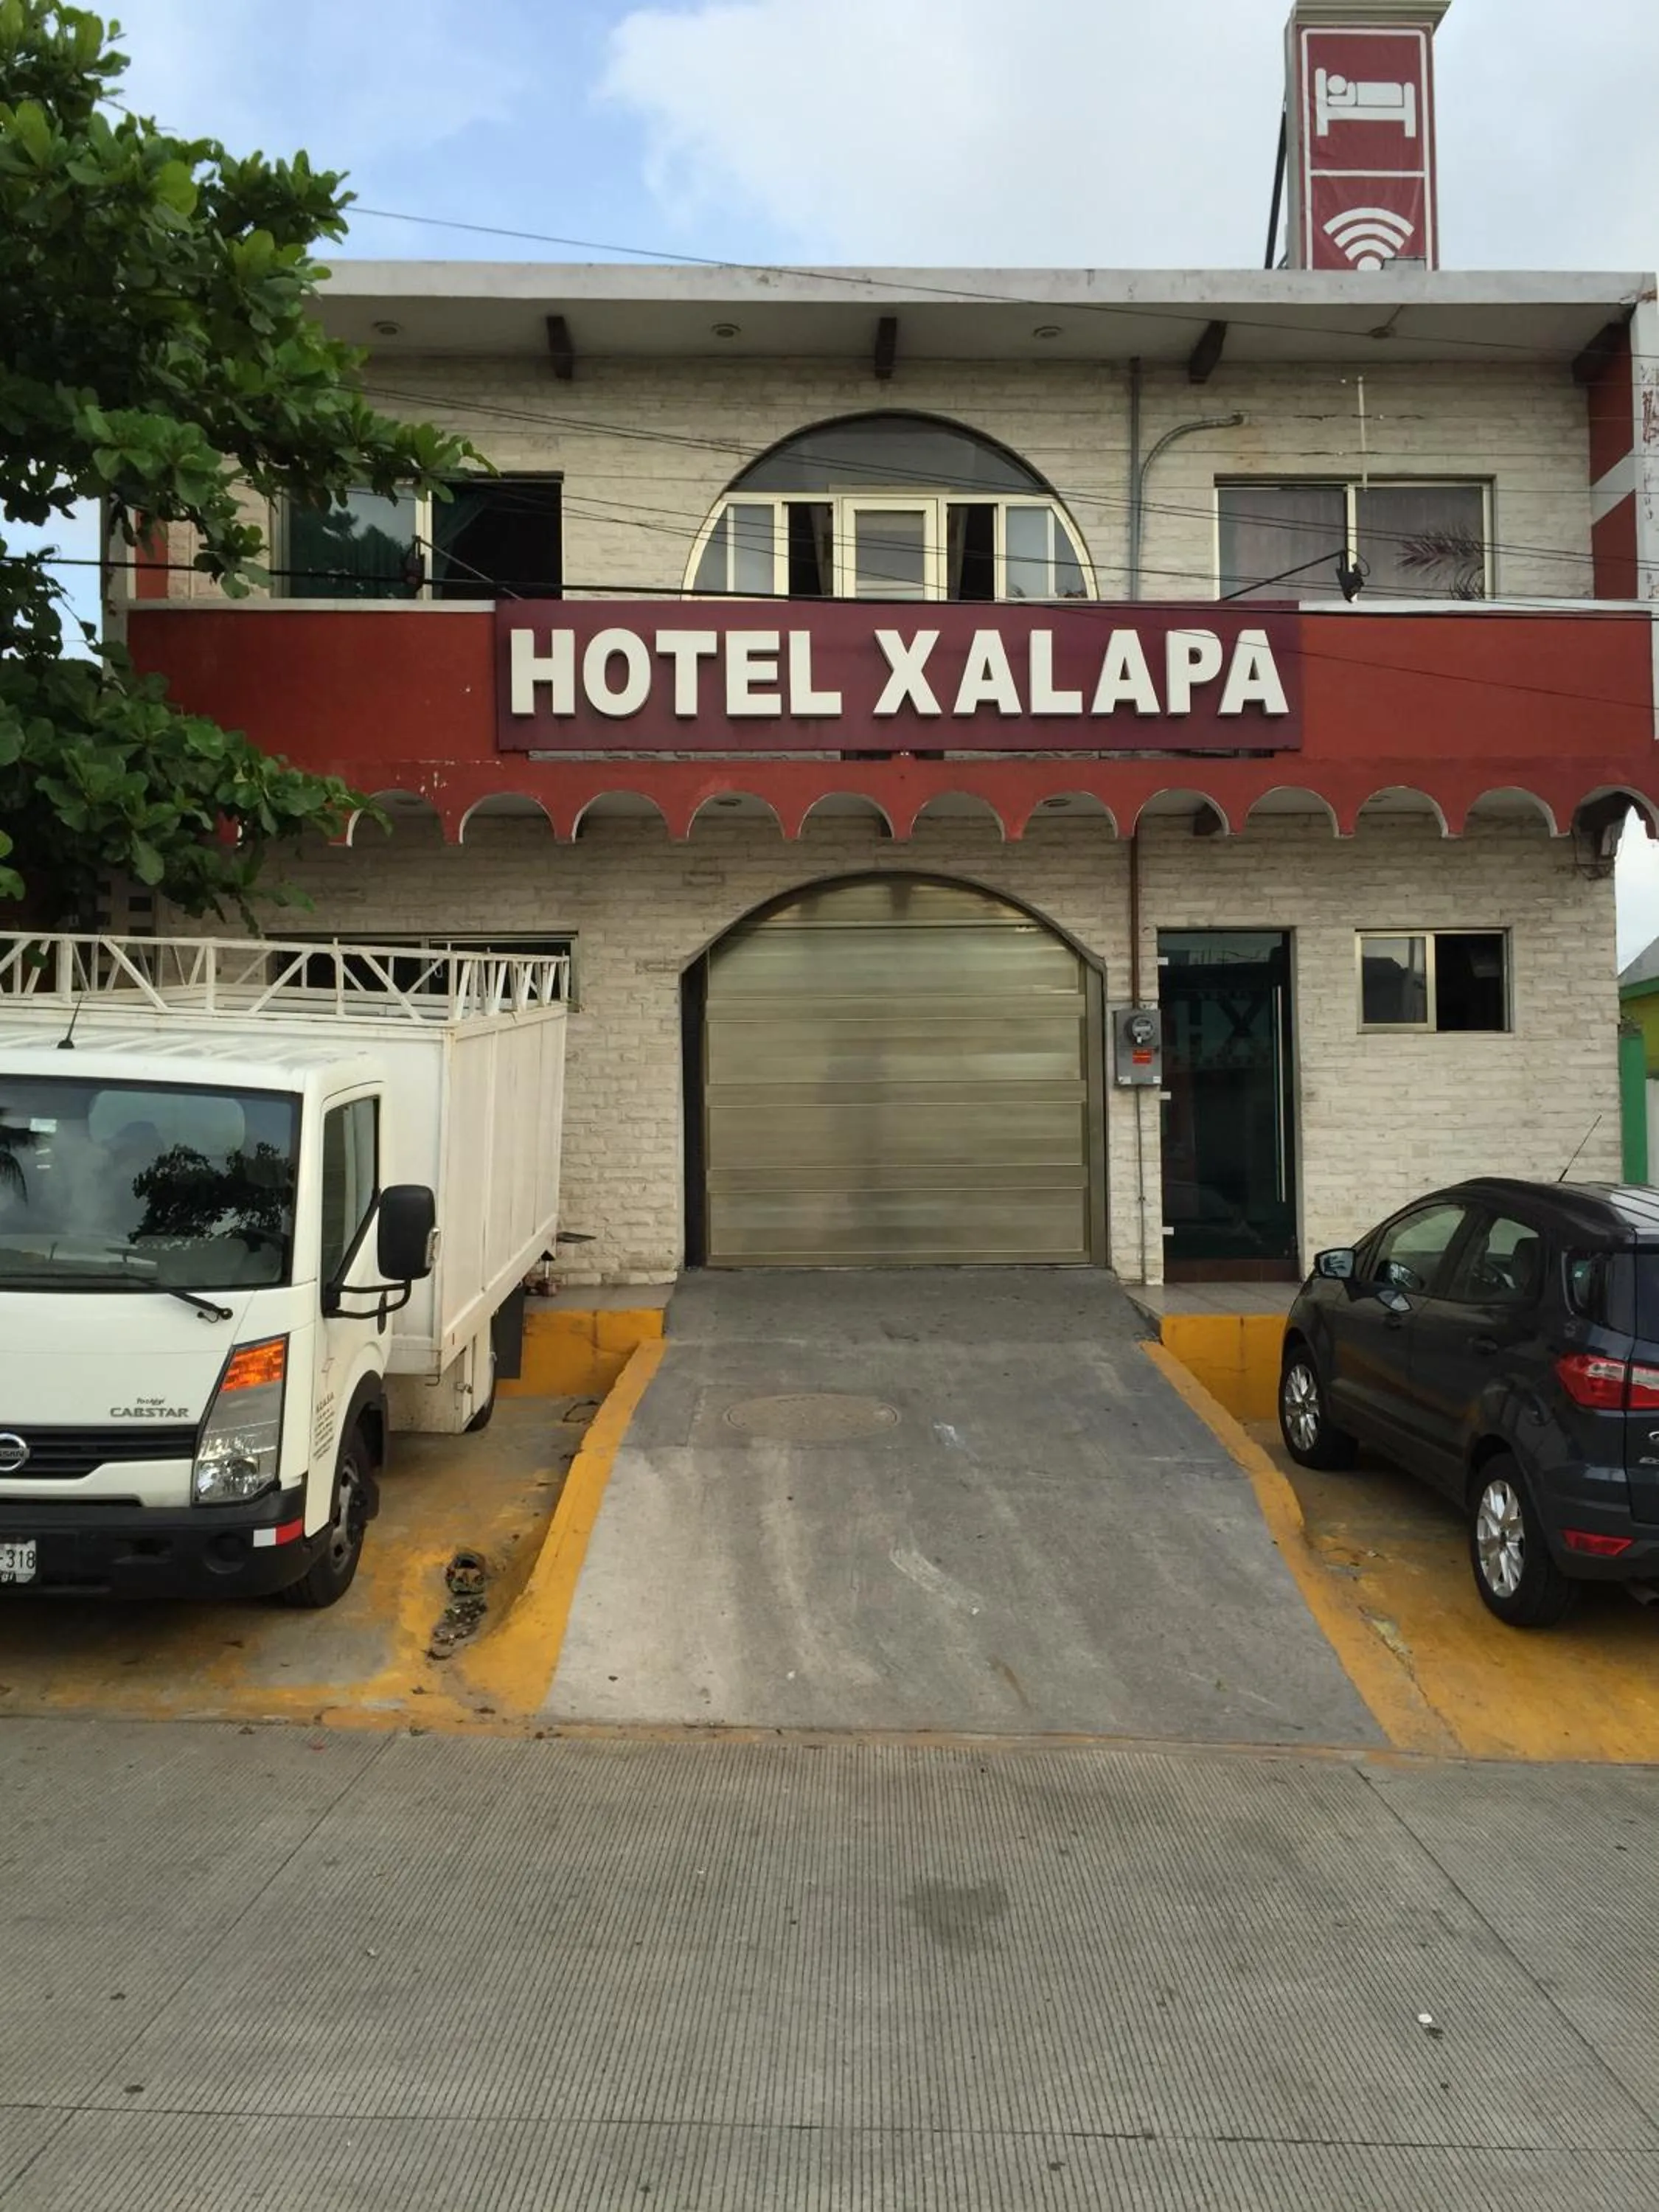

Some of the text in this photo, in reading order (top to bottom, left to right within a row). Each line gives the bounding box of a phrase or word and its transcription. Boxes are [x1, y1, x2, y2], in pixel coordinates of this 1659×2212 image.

[510, 627, 1290, 717] HOTEL XALAPA
[110, 1407, 189, 1418] CABSTAR
